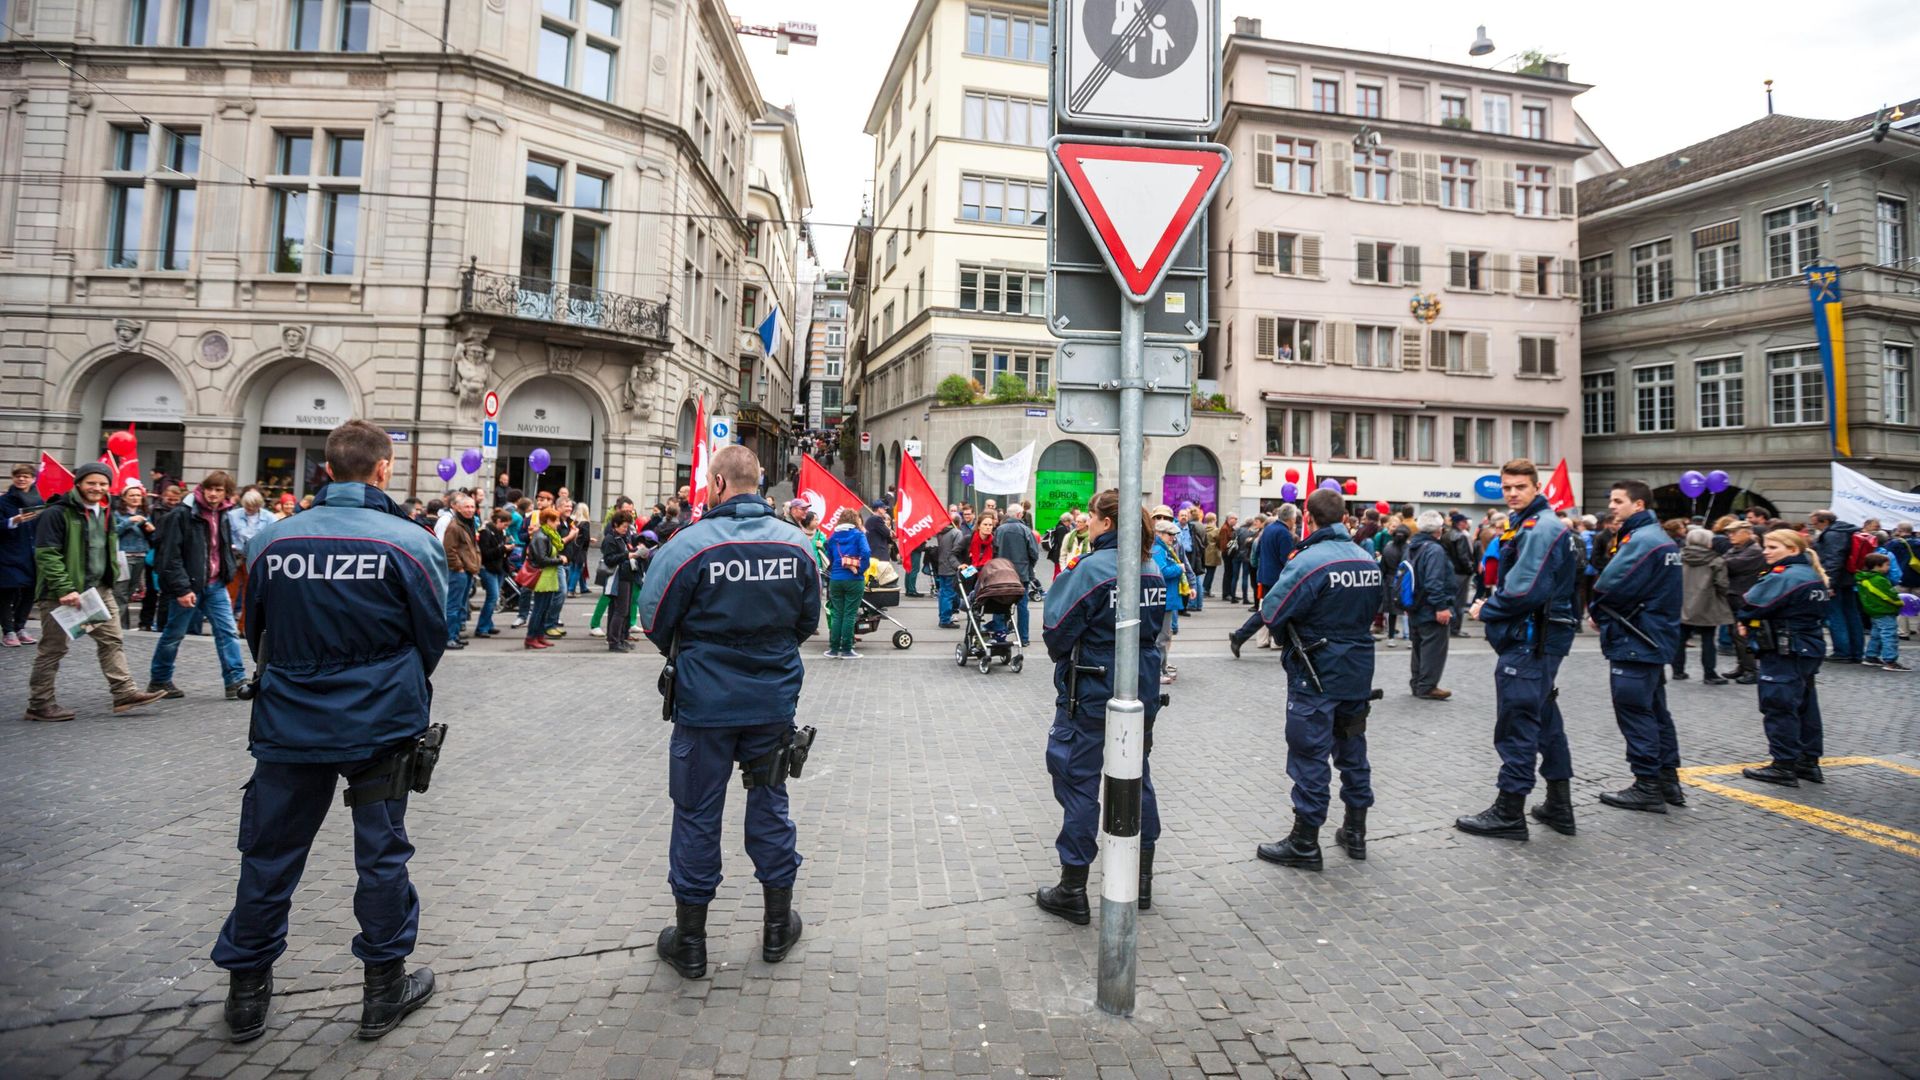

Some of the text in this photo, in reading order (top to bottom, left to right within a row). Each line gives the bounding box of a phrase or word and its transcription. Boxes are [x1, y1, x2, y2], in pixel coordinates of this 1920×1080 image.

[517, 423, 561, 434] NAVYBOOT
[266, 553, 387, 580] POLIZEI
[709, 557, 798, 584] POLIZEI
[1328, 570, 1382, 588] POLIZEI
